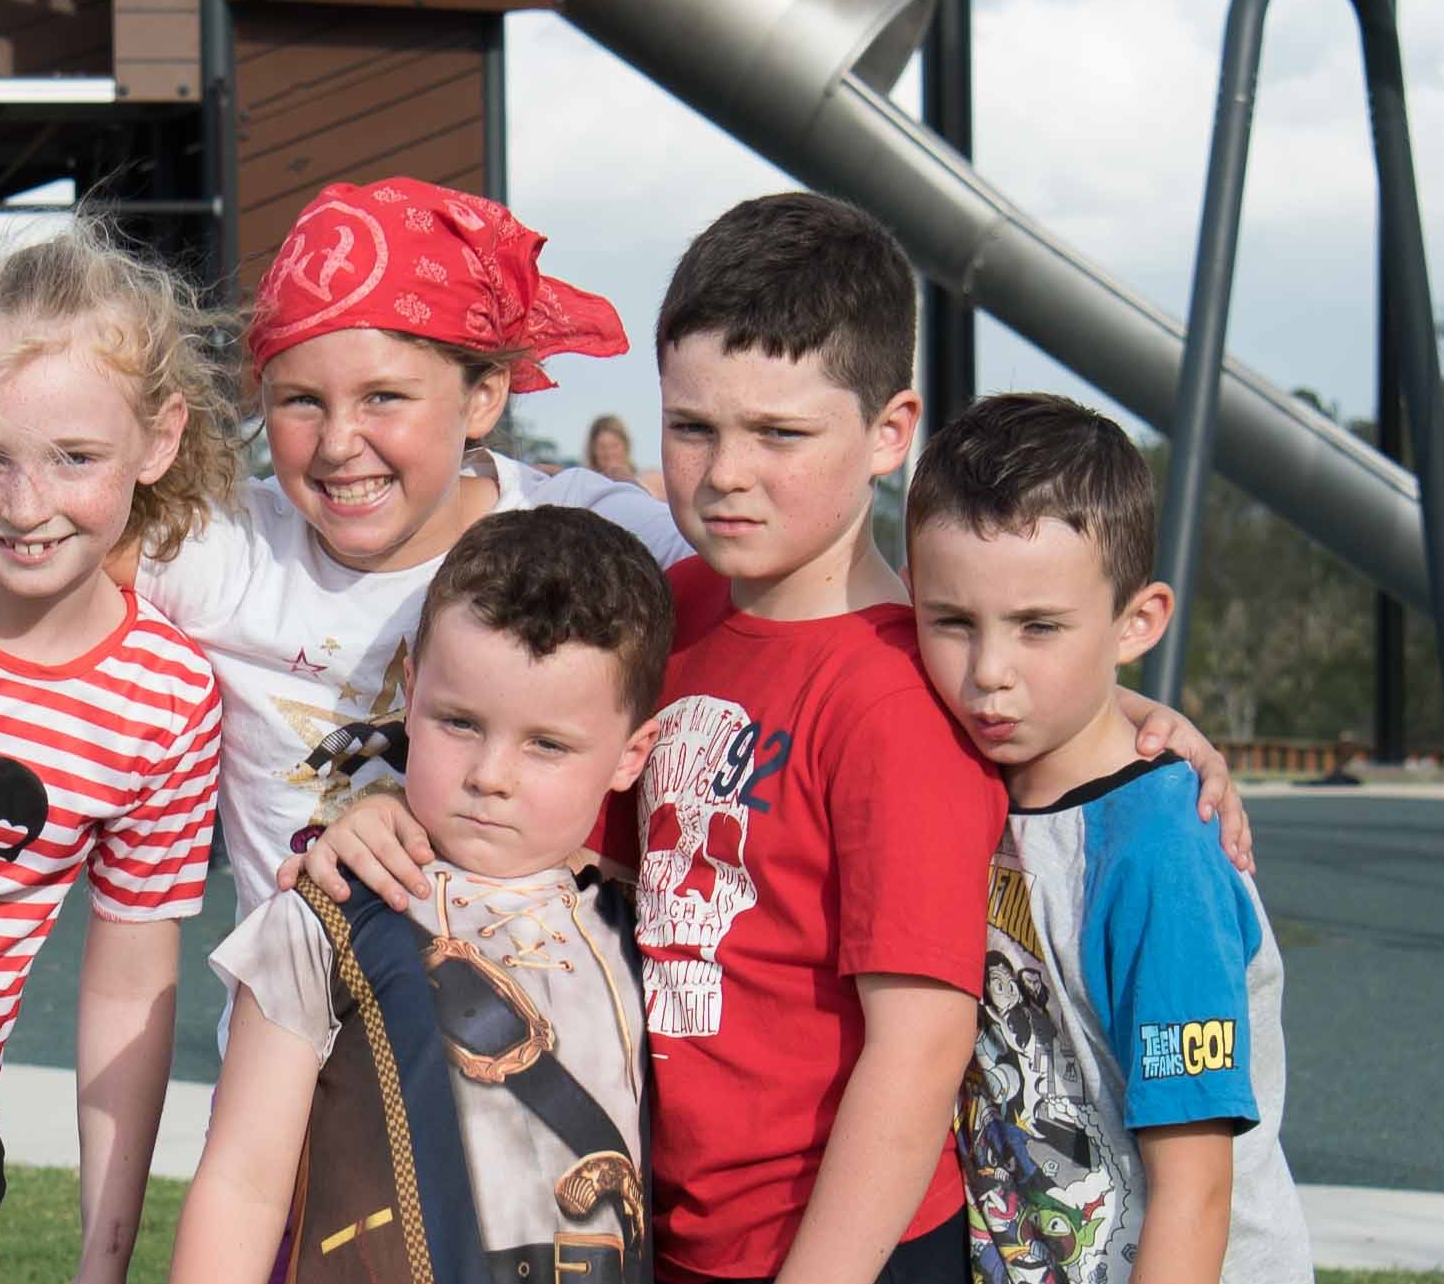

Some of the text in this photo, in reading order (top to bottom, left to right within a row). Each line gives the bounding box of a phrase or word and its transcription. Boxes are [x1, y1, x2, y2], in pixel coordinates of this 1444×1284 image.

[713, 721, 793, 813] 92
[660, 990, 718, 1034] LEAGUE
[1141, 1024, 1181, 1056] TEEN
[1182, 1019, 1235, 1076] GO!
